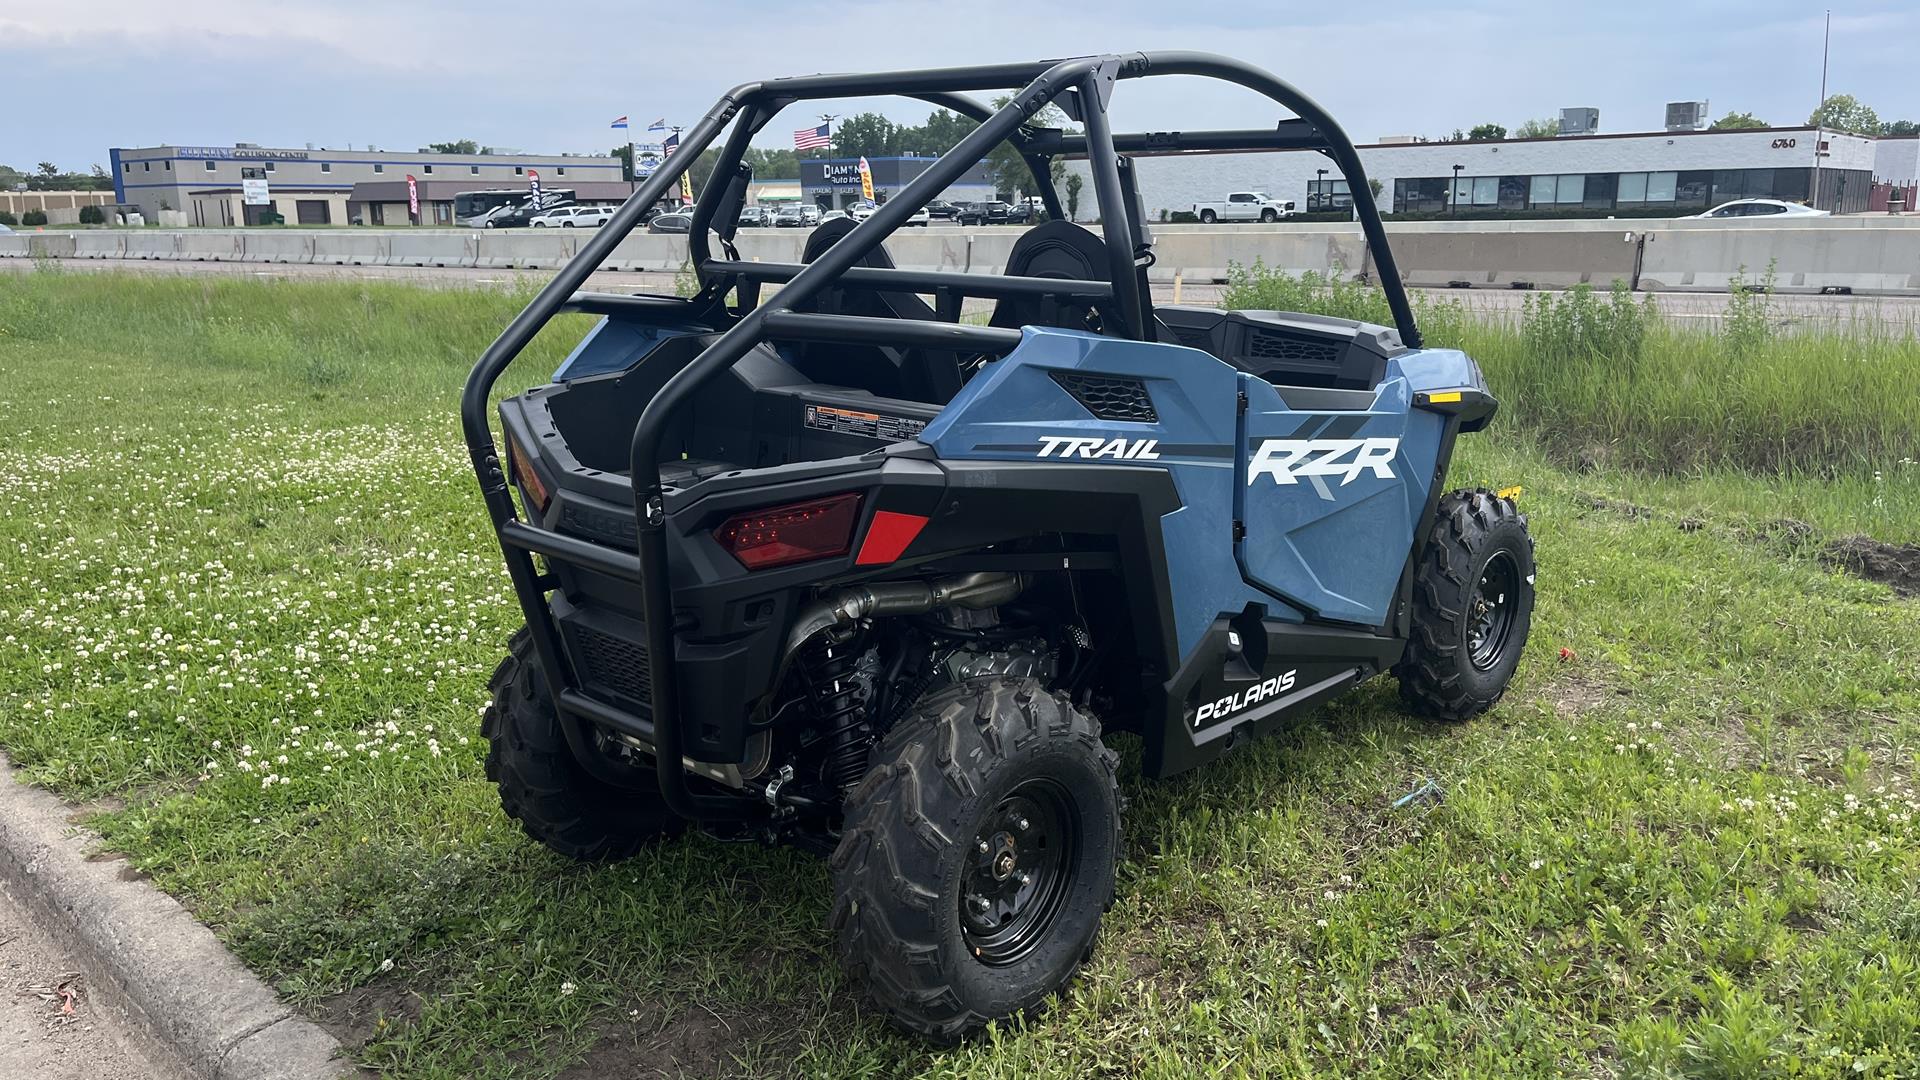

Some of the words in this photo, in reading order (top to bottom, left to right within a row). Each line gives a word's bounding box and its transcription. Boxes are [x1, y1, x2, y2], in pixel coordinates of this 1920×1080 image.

[1771, 139, 1796, 148] 6760
[530, 181, 541, 210] CARS
[1036, 435, 1161, 460] TRAIL
[1247, 437, 1400, 487] RZR
[1193, 668, 1297, 727] POLARIS
